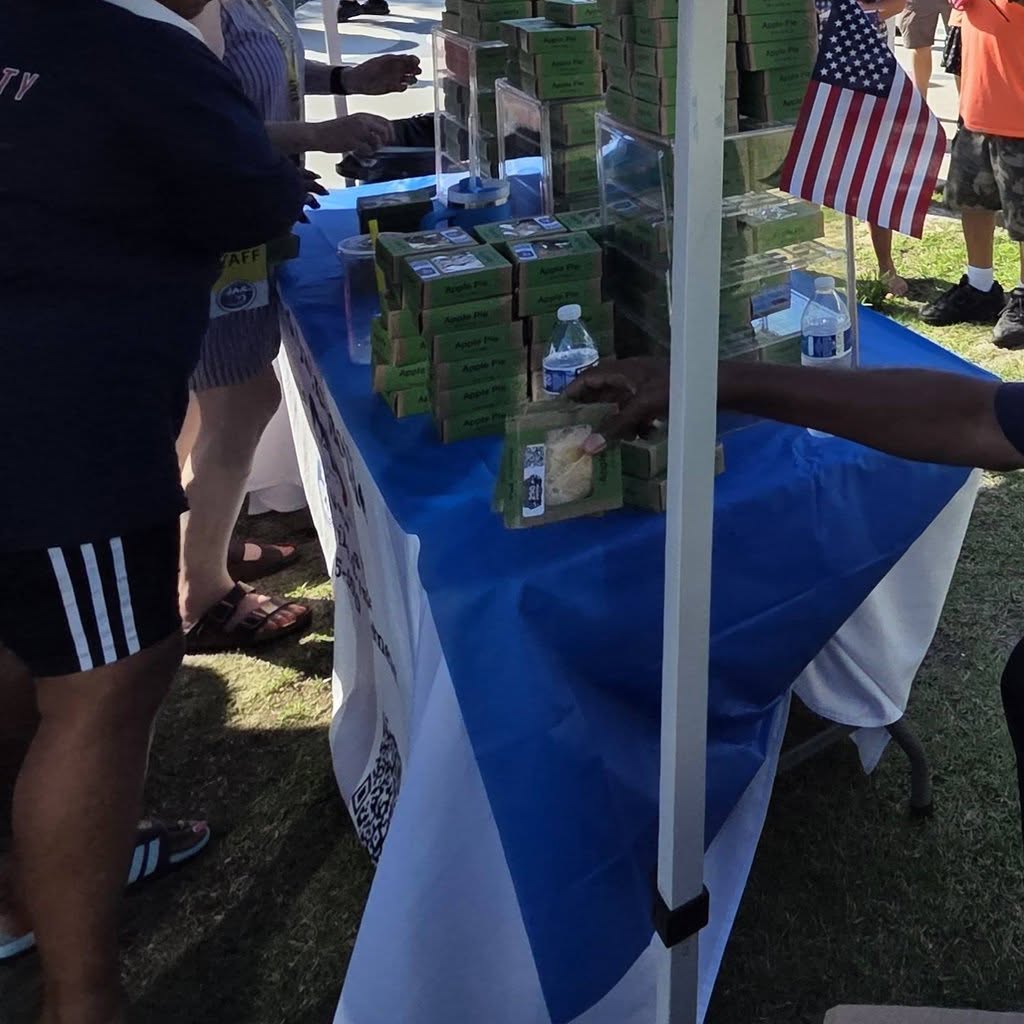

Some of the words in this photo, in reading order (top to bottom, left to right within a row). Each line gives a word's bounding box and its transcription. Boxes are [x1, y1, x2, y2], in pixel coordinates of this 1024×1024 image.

[224, 249, 260, 266] AFF
[445, 282, 472, 293] Apple
[444, 312, 472, 323] Apple
[462, 361, 489, 372] Apple
[463, 388, 489, 400] Apple
